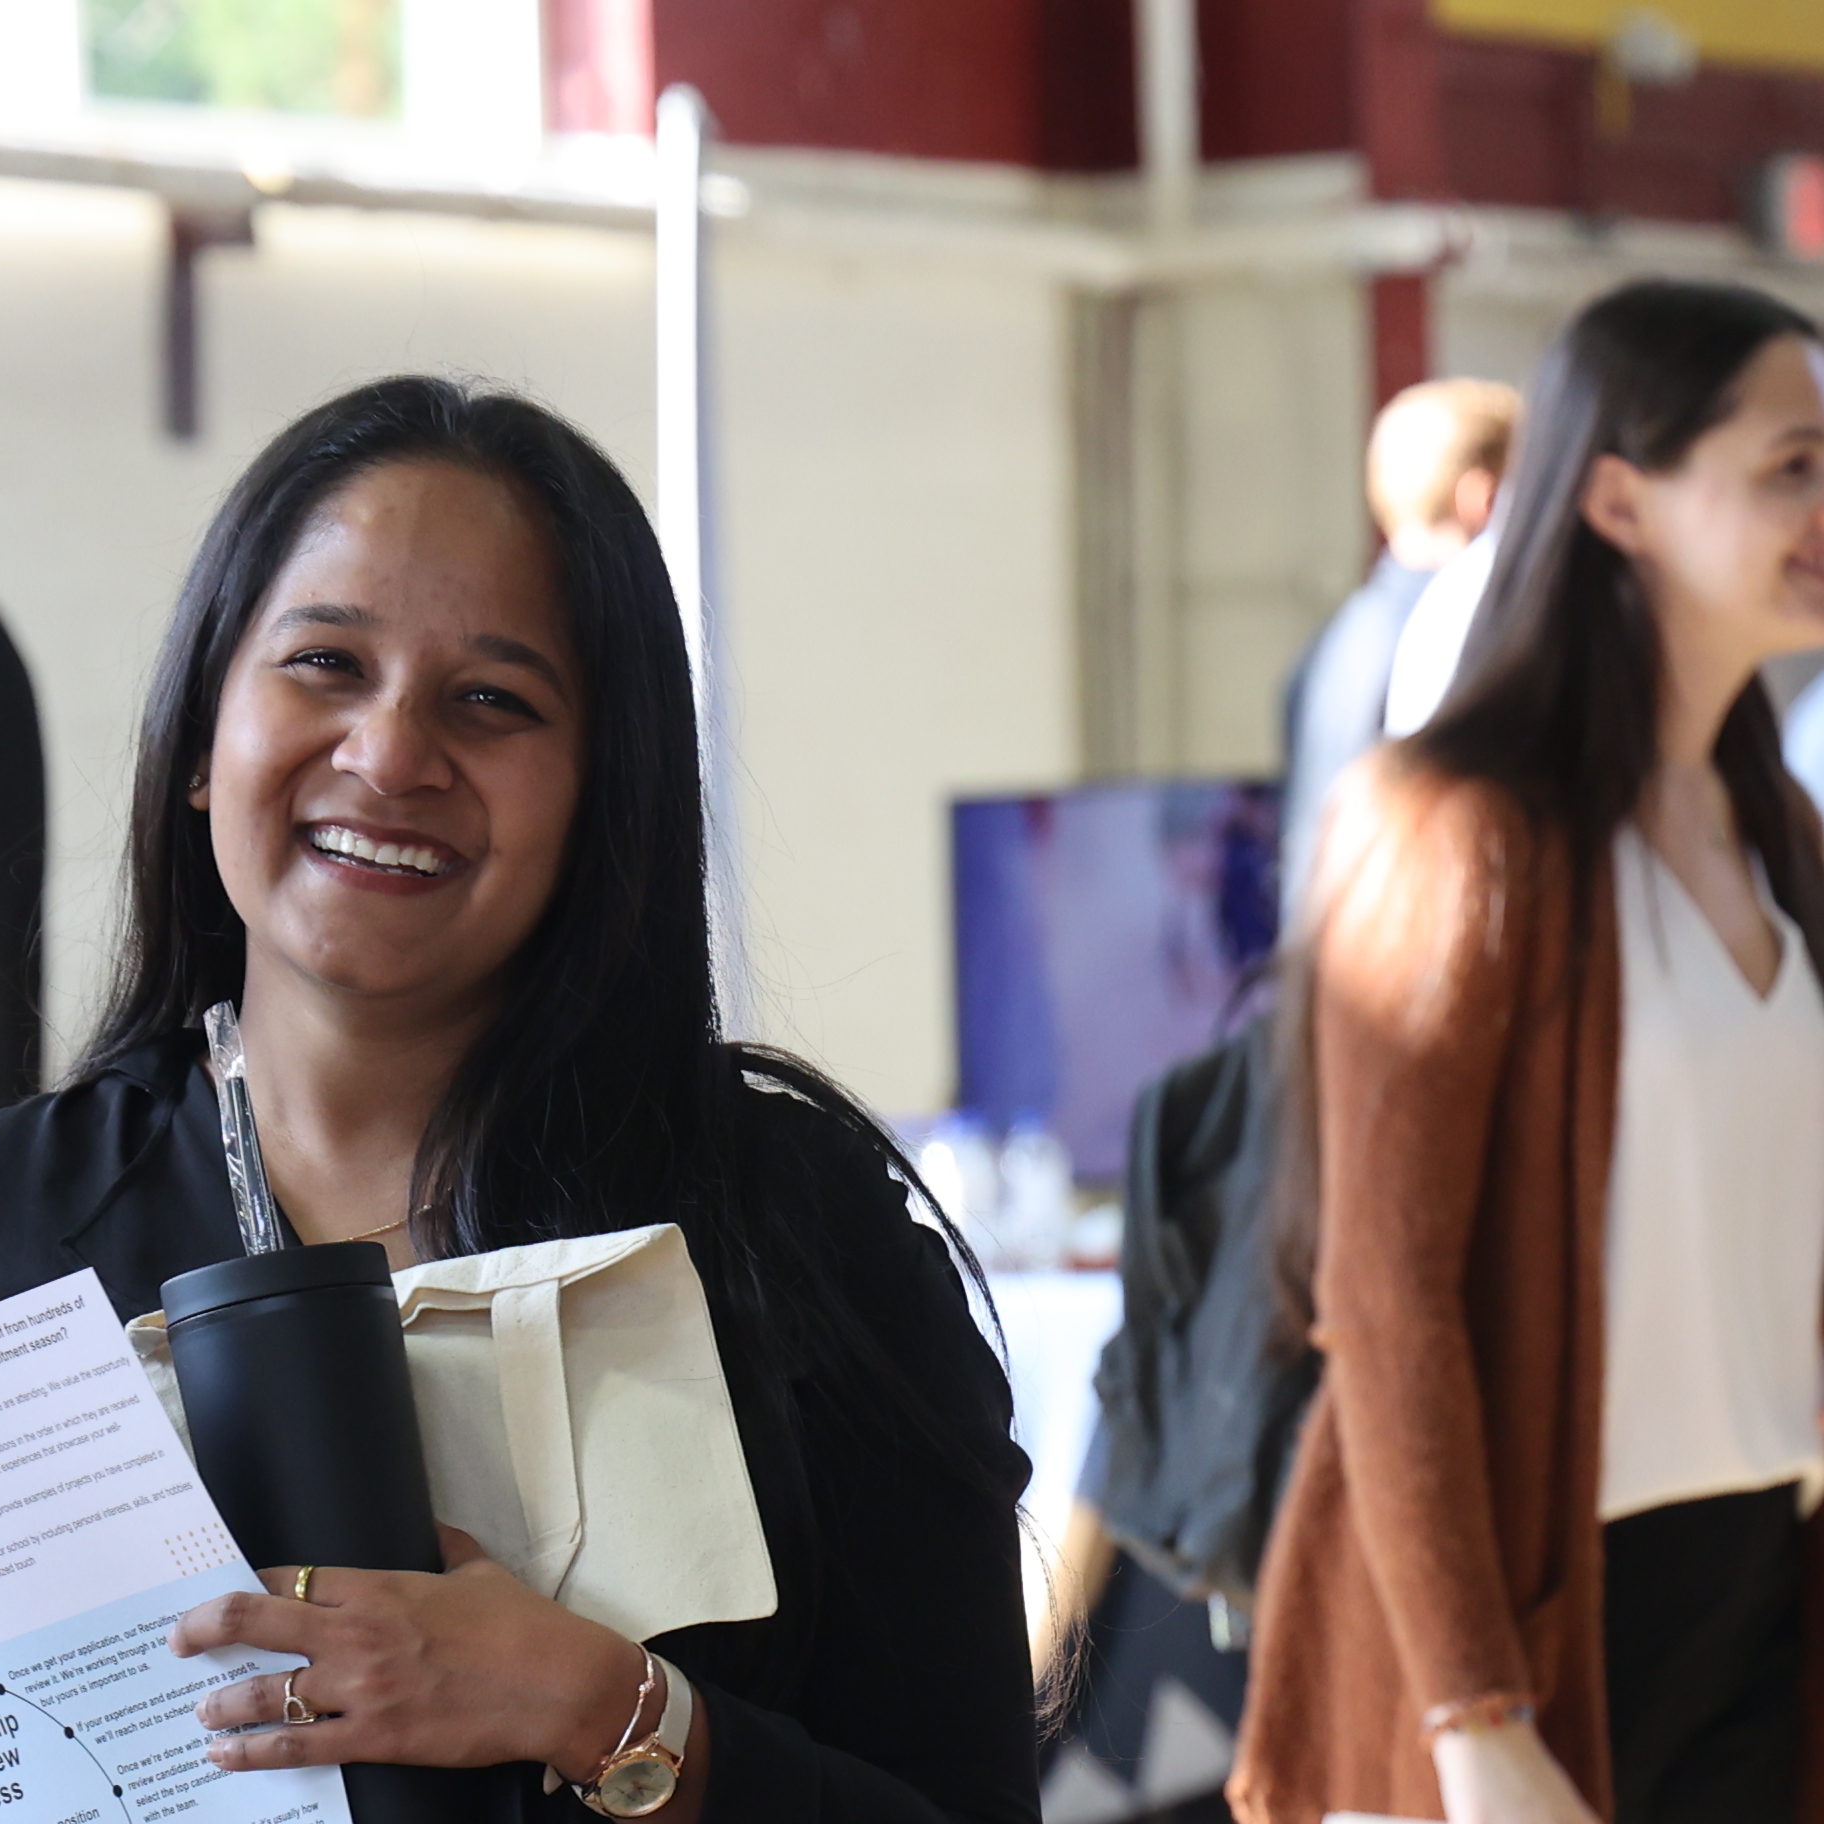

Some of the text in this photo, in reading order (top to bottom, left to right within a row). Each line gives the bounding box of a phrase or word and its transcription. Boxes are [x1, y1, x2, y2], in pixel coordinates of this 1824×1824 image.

[3, 1319, 28, 1334] from
[26, 1302, 74, 1326] hundreds
[73, 1294, 85, 1309] of
[28, 1326, 68, 1351] season?
[13, 1556, 37, 1570] touch
[7, 1614, 179, 1680] Once we get your application, our Recruiting
[24, 1635, 168, 1693] review it. We're working through a lot
[39, 1662, 151, 1709] but yours is important to us.
[75, 1720, 84, 1731] If
[83, 1716, 103, 1732] your
[103, 1700, 149, 1722] experience
[148, 1692, 166, 1706] and
[165, 1680, 207, 1700] education
[206, 1675, 221, 1685] are
[220, 1672, 228, 1680] a
[227, 1664, 248, 1680] good
[94, 1729, 115, 1744] we'll
[114, 1722, 139, 1737] reach
[138, 1716, 154, 1729] out
[152, 1714, 164, 1724] to
[116, 1761, 140, 1775] Once
[139, 1753, 163, 1767] we're
[162, 1745, 184, 1759] done
[184, 1738, 203, 1751] with
[203, 1733, 215, 1744] all
[127, 1775, 155, 1790] review
[135, 1791, 161, 1807] select
[160, 1787, 175, 1798] the
[174, 1782, 190, 1793] top
[143, 1798, 199, 1823] with the team.
[272, 1808, 301, 1824] usually
[300, 1802, 319, 1814] how
